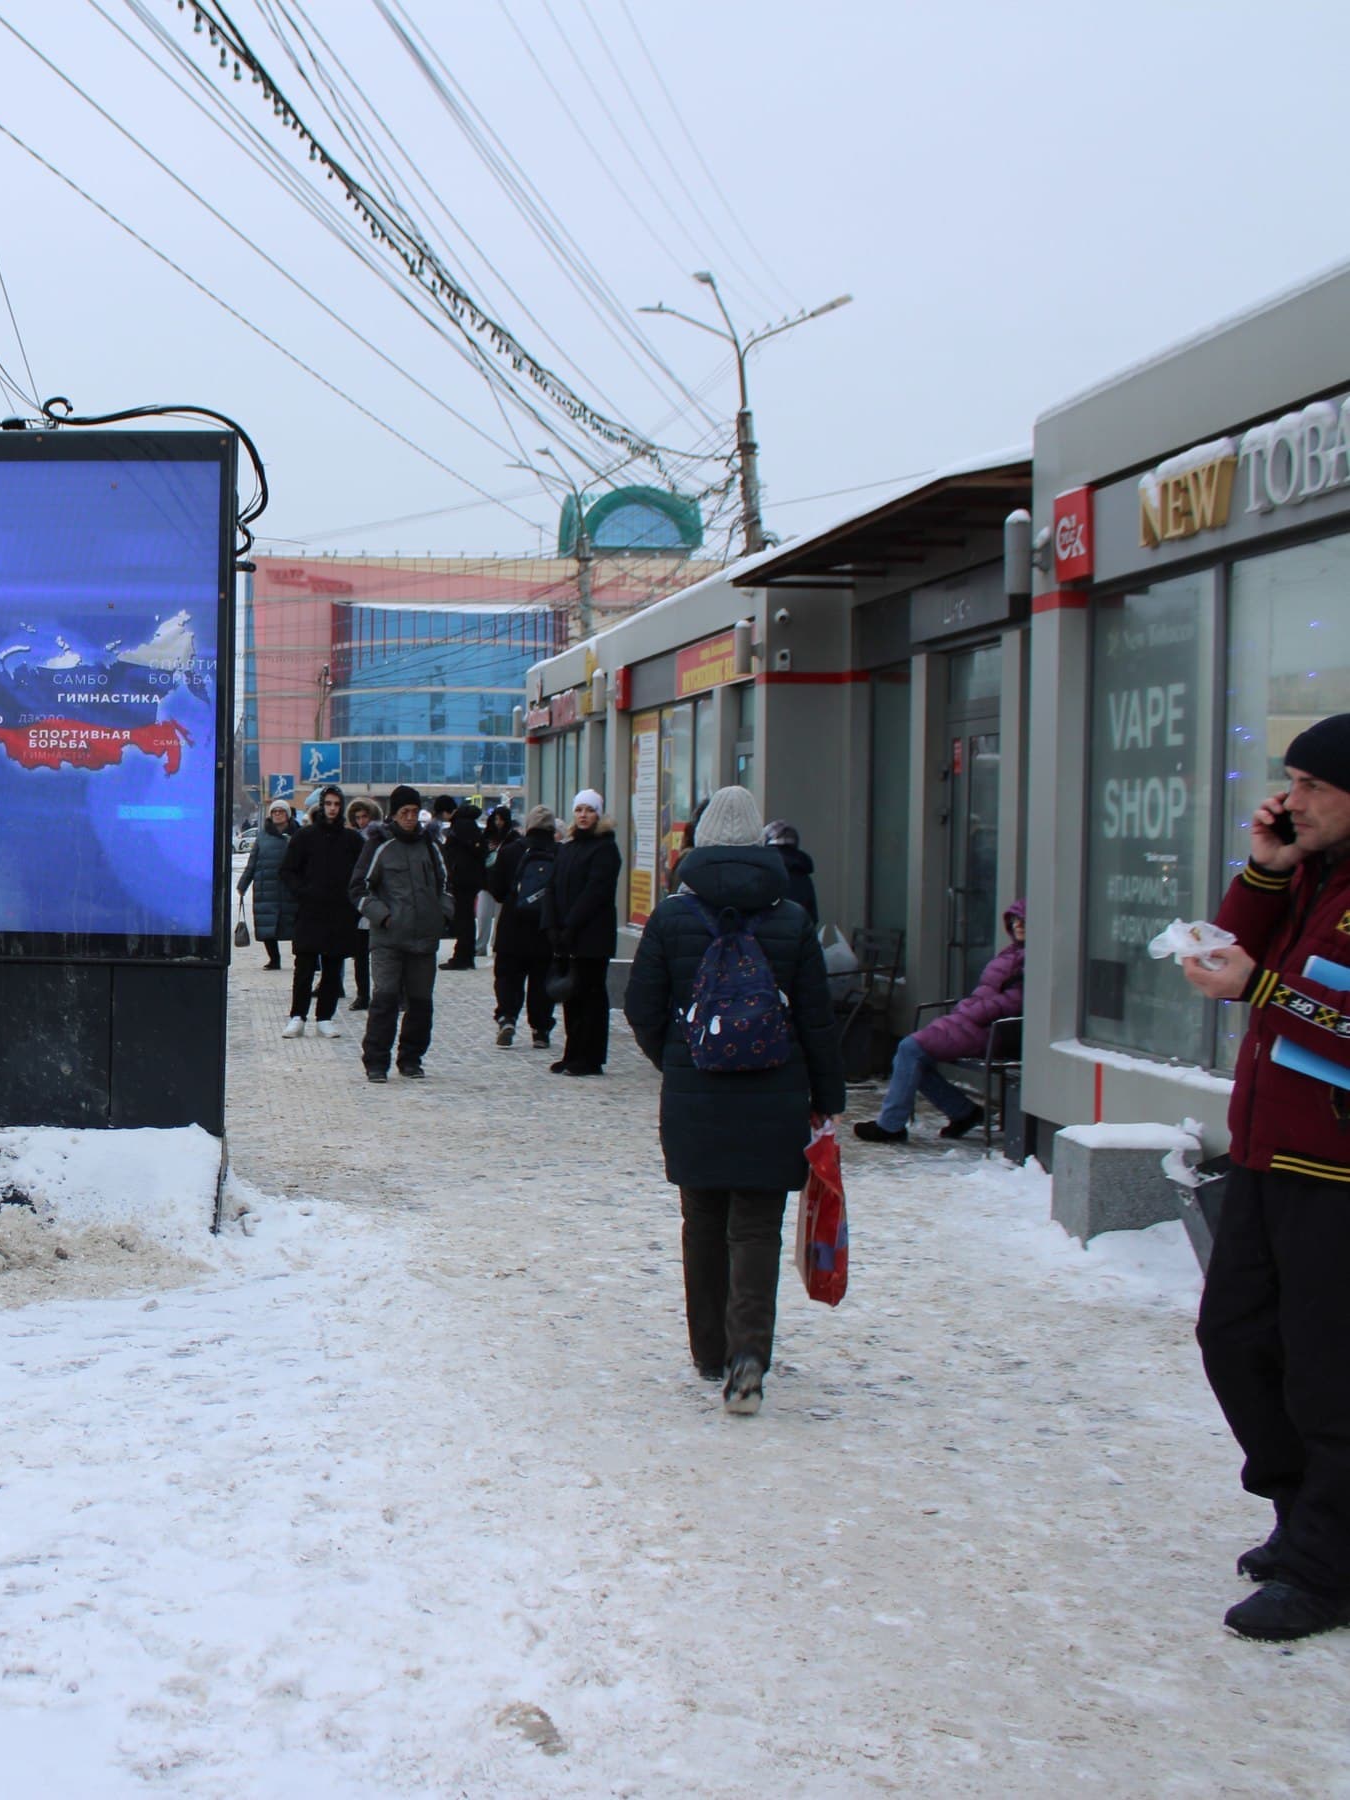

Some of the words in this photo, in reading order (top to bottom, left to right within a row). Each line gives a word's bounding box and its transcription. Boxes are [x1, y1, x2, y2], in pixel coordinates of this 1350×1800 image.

[1139, 456, 1237, 548] NEW
[52, 673, 108, 685] САМБО
[57, 693, 161, 703] ГИМНАСТИКА
[1109, 683, 1185, 751] VAPE
[29, 729, 131, 739] СПОРТИВНАЯ
[29, 740, 88, 749] БОРЬБА
[1103, 776, 1187, 839] SHOP
